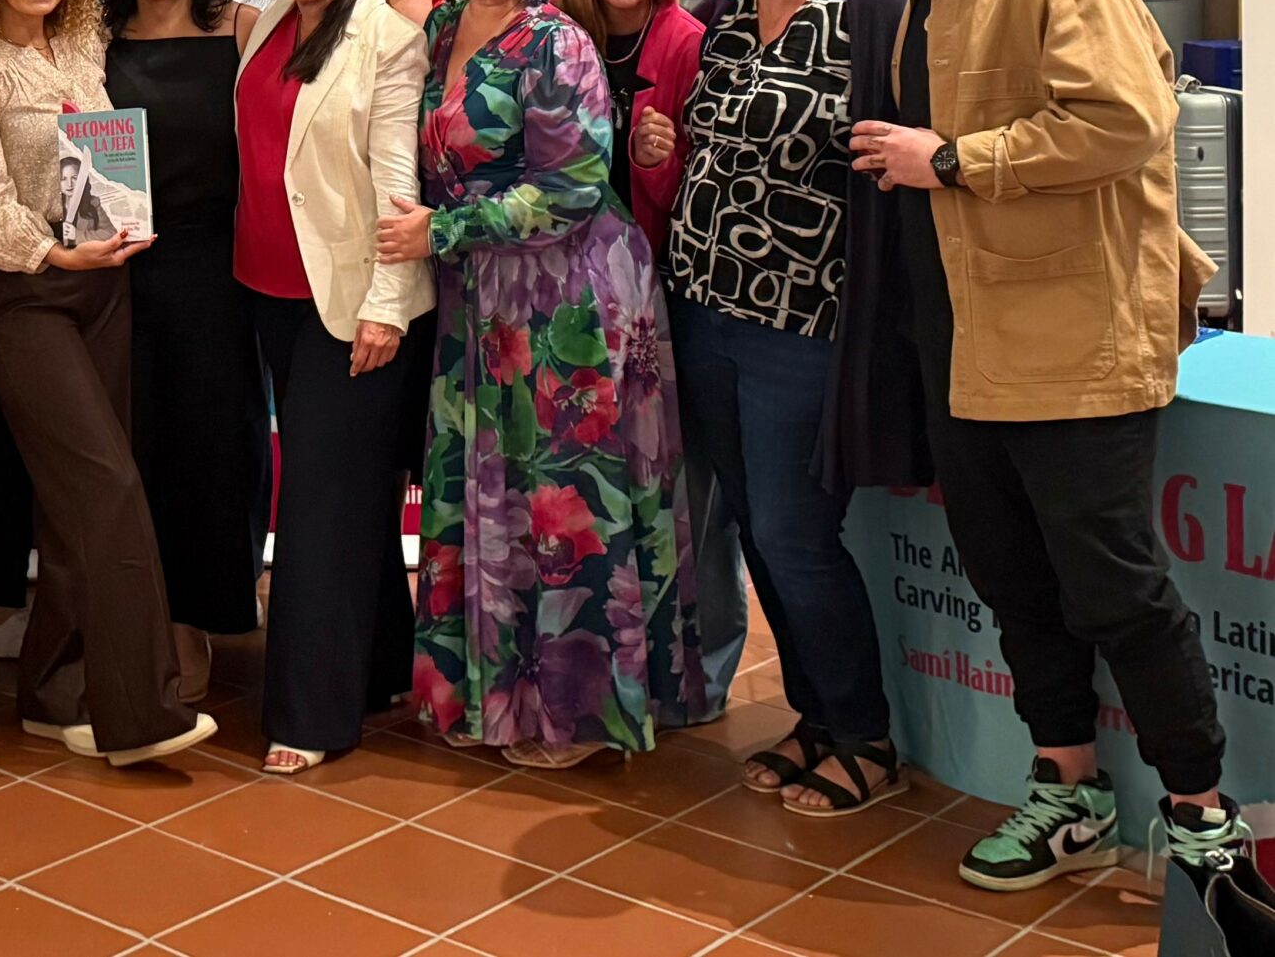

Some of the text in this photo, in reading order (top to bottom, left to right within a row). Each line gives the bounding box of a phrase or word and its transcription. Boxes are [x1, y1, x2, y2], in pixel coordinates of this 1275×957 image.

[66, 117, 135, 142] BECOMING
[94, 136, 136, 154] LA JEFA
[891, 532, 931, 568] The
[894, 575, 982, 633] Carving
[1209, 662, 1275, 706] erica
